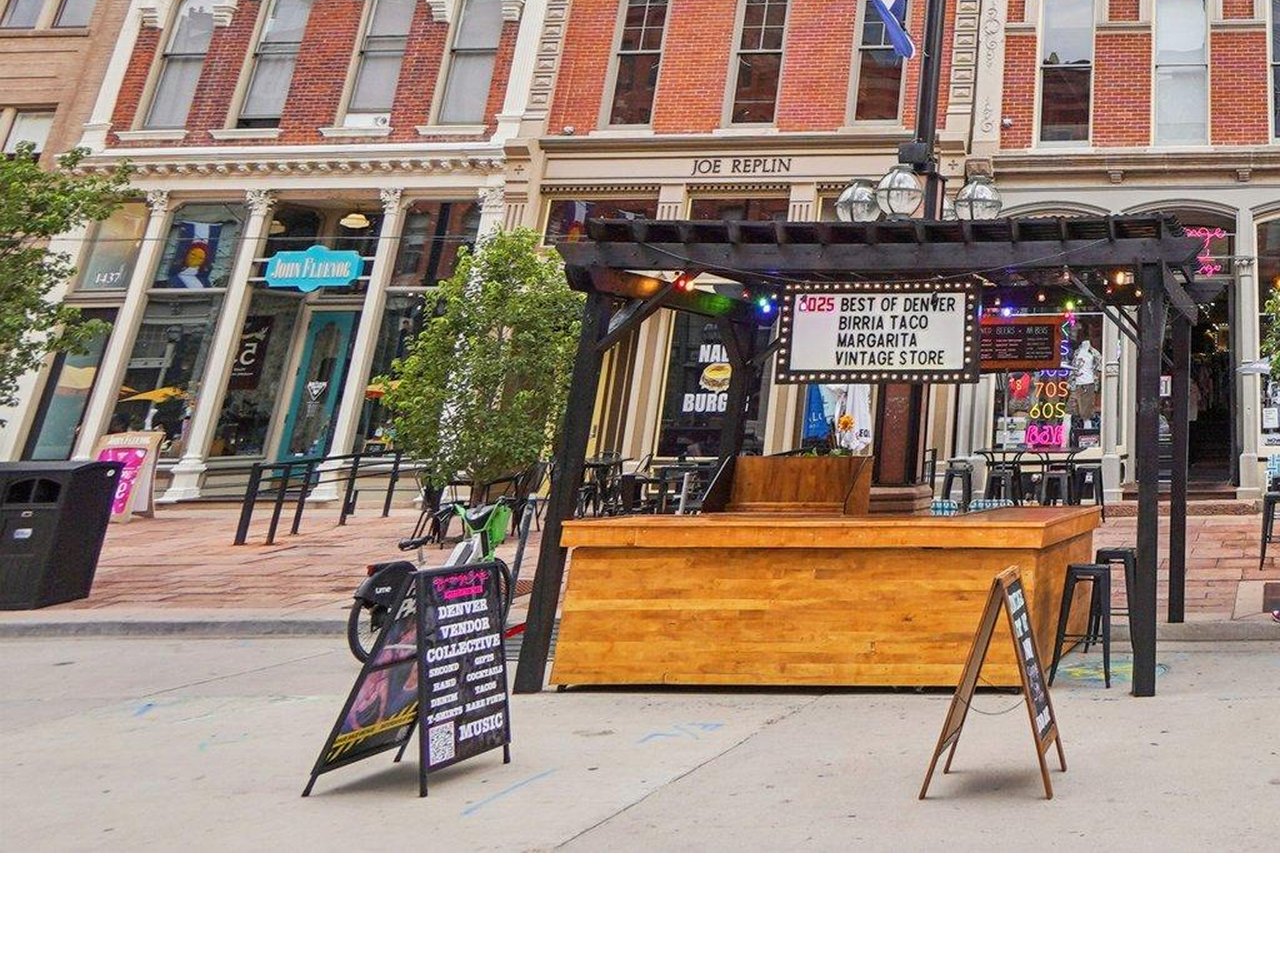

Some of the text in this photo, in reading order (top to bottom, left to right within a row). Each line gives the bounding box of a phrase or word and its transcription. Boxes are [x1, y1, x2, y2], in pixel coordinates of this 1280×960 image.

[691, 158, 792, 176] JOE REPLIN
[95, 271, 121, 283] 1437
[271, 259, 301, 279] JOHN
[840, 297, 875, 312] BEST
[880, 297, 897, 312] OF
[903, 297, 956, 312] DENVER
[838, 314, 928, 331] BIRRIA TACO
[836, 332, 918, 348] MARGARITA
[835, 350, 945, 366] VINTAGE STORE
[1034, 381, 1068, 397] 70S
[1030, 402, 1066, 419] 60S
[438, 598, 488, 620] DENVER
[440, 617, 490, 639] VENDOR
[426, 633, 500, 663] COLLECTIVE
[474, 653, 494, 665] GIFTS
[428, 662, 460, 678] SECOND
[466, 665, 504, 682] COCKTAILS
[432, 678, 457, 692] HAND
[474, 681, 497, 695] TACOS
[430, 692, 459, 708] DENIM
[465, 692, 506, 713] RARE FINDS
[427, 706, 464, 724] T-SHIRTS
[459, 712, 503, 741] MUSIC
